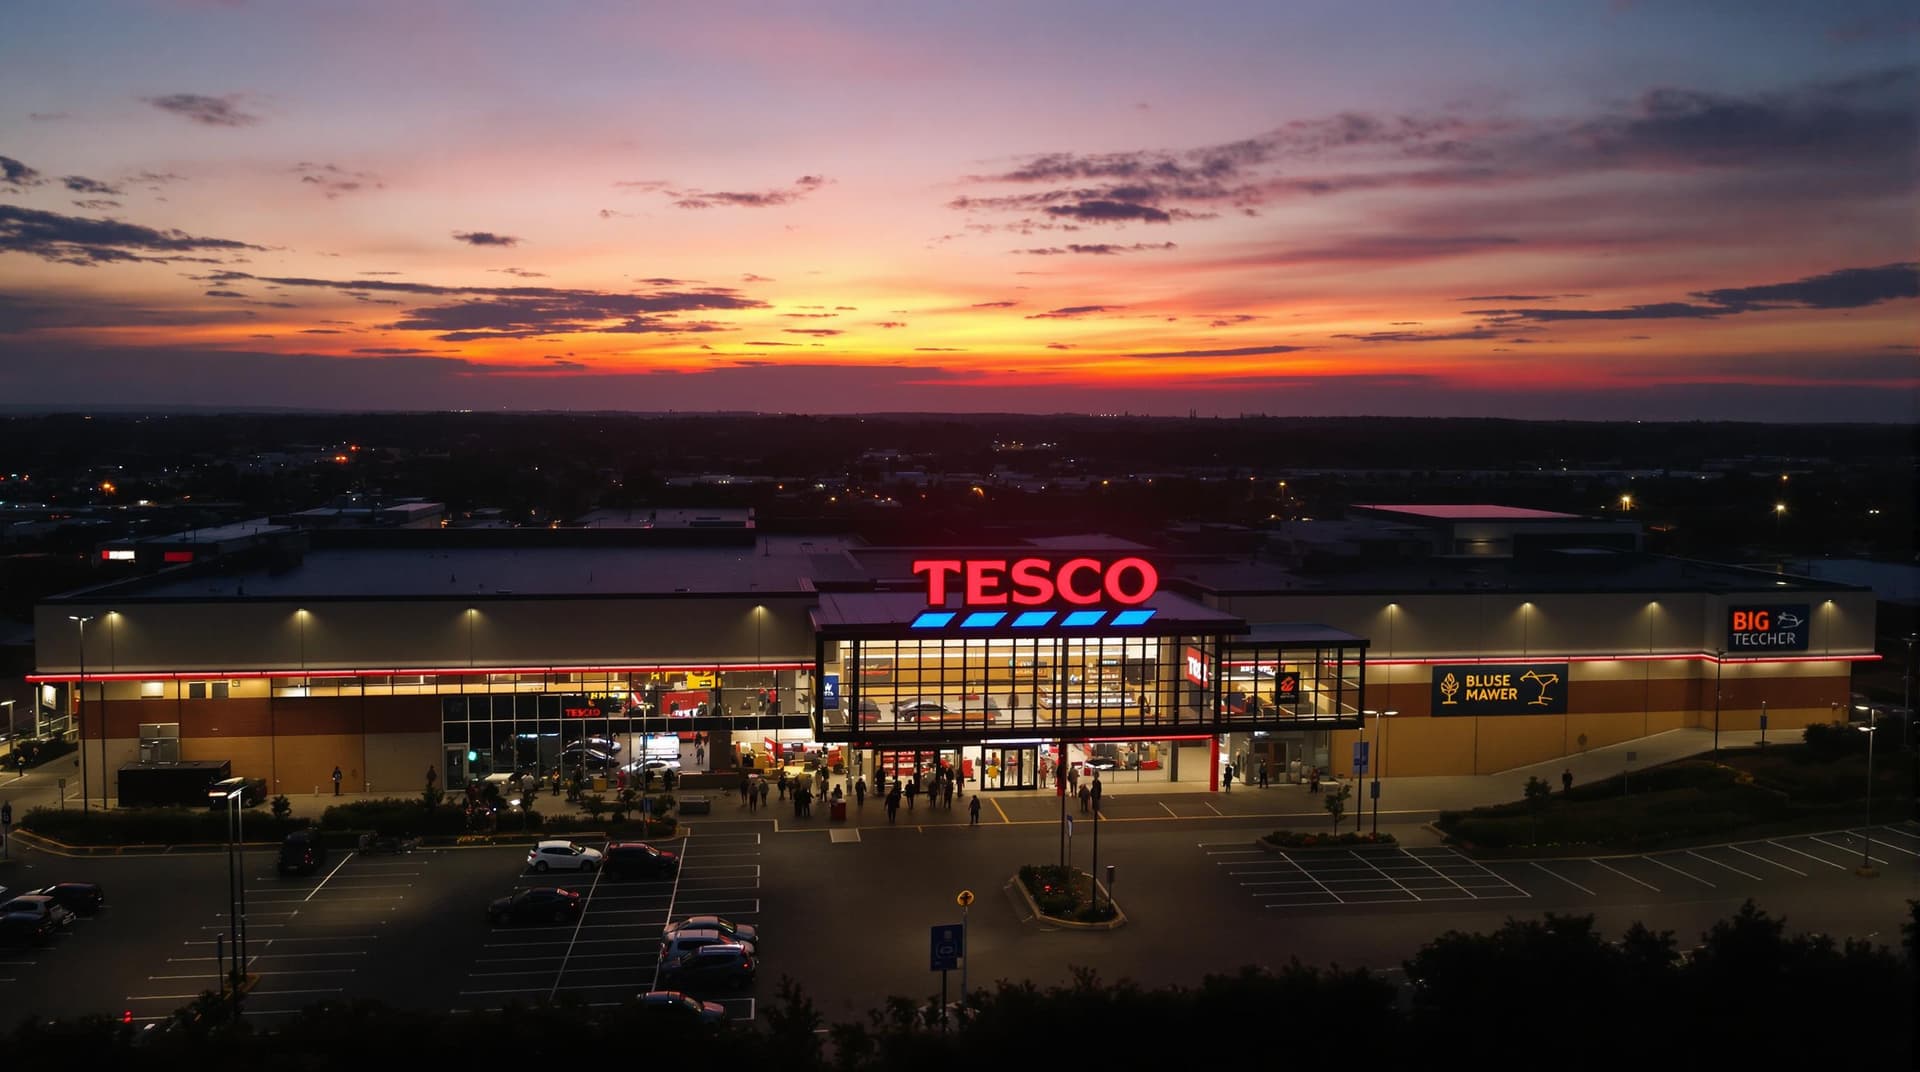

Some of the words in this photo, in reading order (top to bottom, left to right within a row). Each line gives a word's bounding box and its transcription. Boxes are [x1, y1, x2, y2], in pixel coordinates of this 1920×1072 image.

[913, 558, 1158, 605] TESCO
[1733, 611, 1770, 631] BIG
[1466, 674, 1512, 687] BLUSE
[1466, 688, 1518, 700] MAWER
